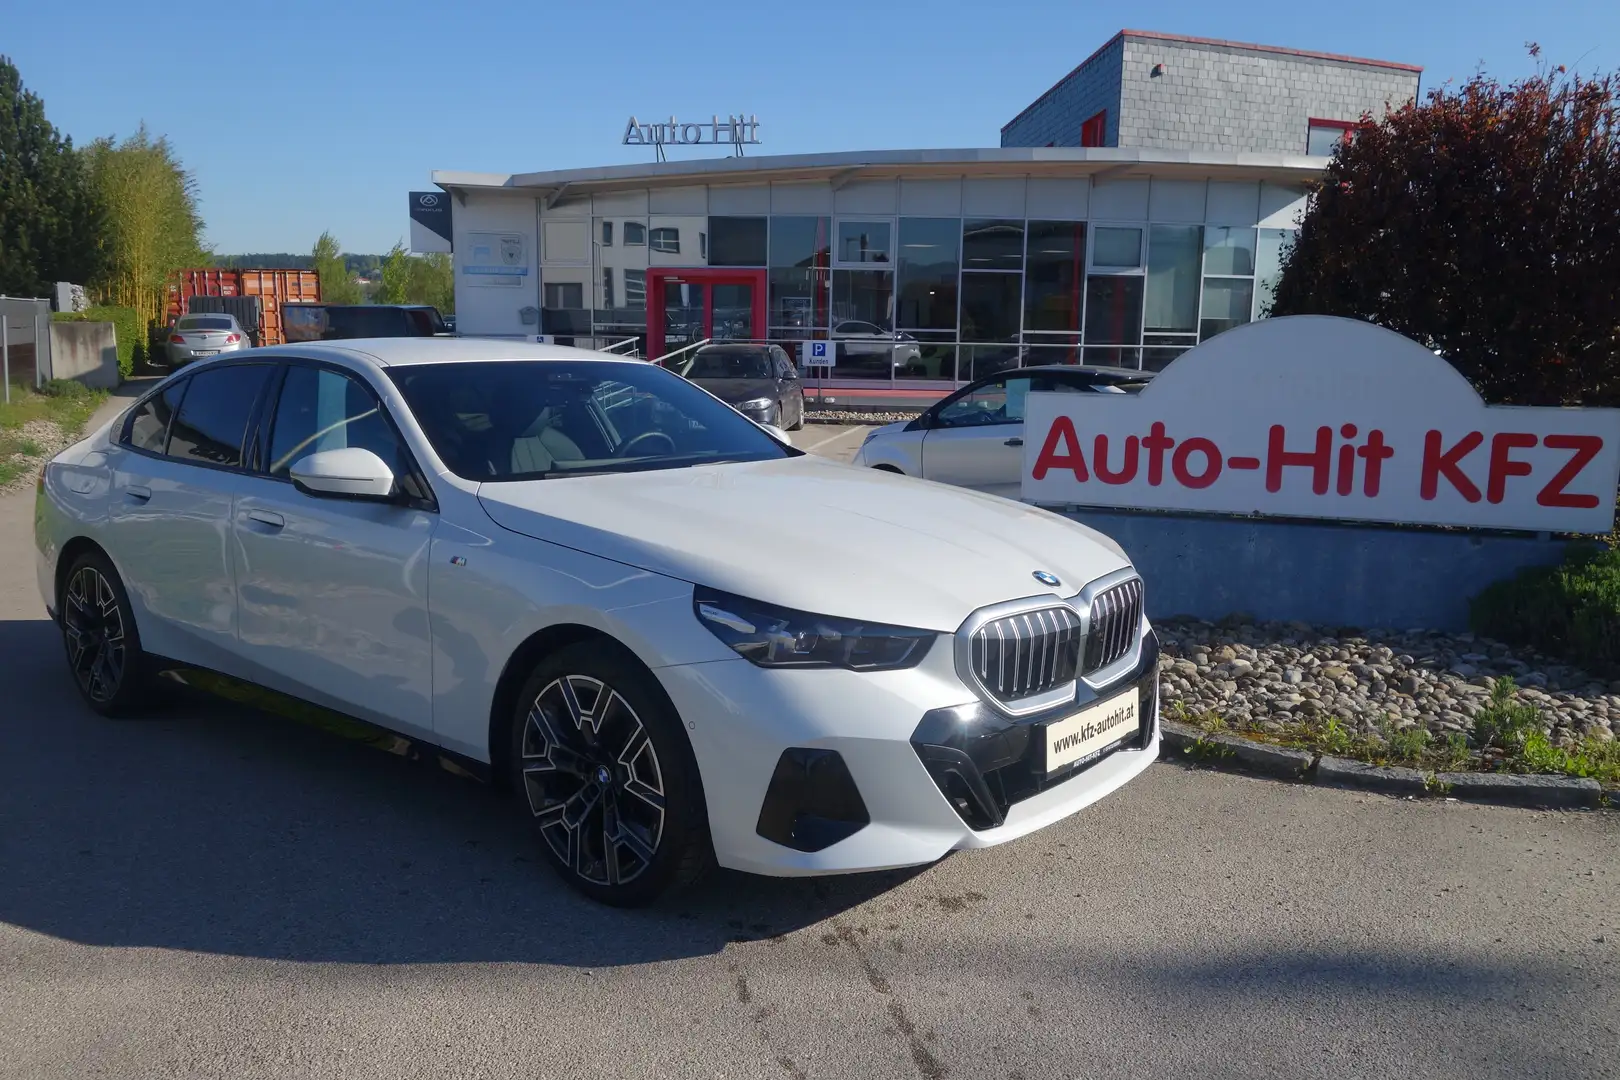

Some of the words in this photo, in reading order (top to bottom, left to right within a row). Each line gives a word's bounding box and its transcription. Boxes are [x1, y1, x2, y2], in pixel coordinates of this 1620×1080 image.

[622, 115, 701, 144] Auto
[713, 114, 761, 144] Hit
[1032, 415, 1394, 498] Auto-Hit
[1420, 429, 1604, 509] KFZ
[1053, 702, 1134, 754] www.kfz-autohit.at
